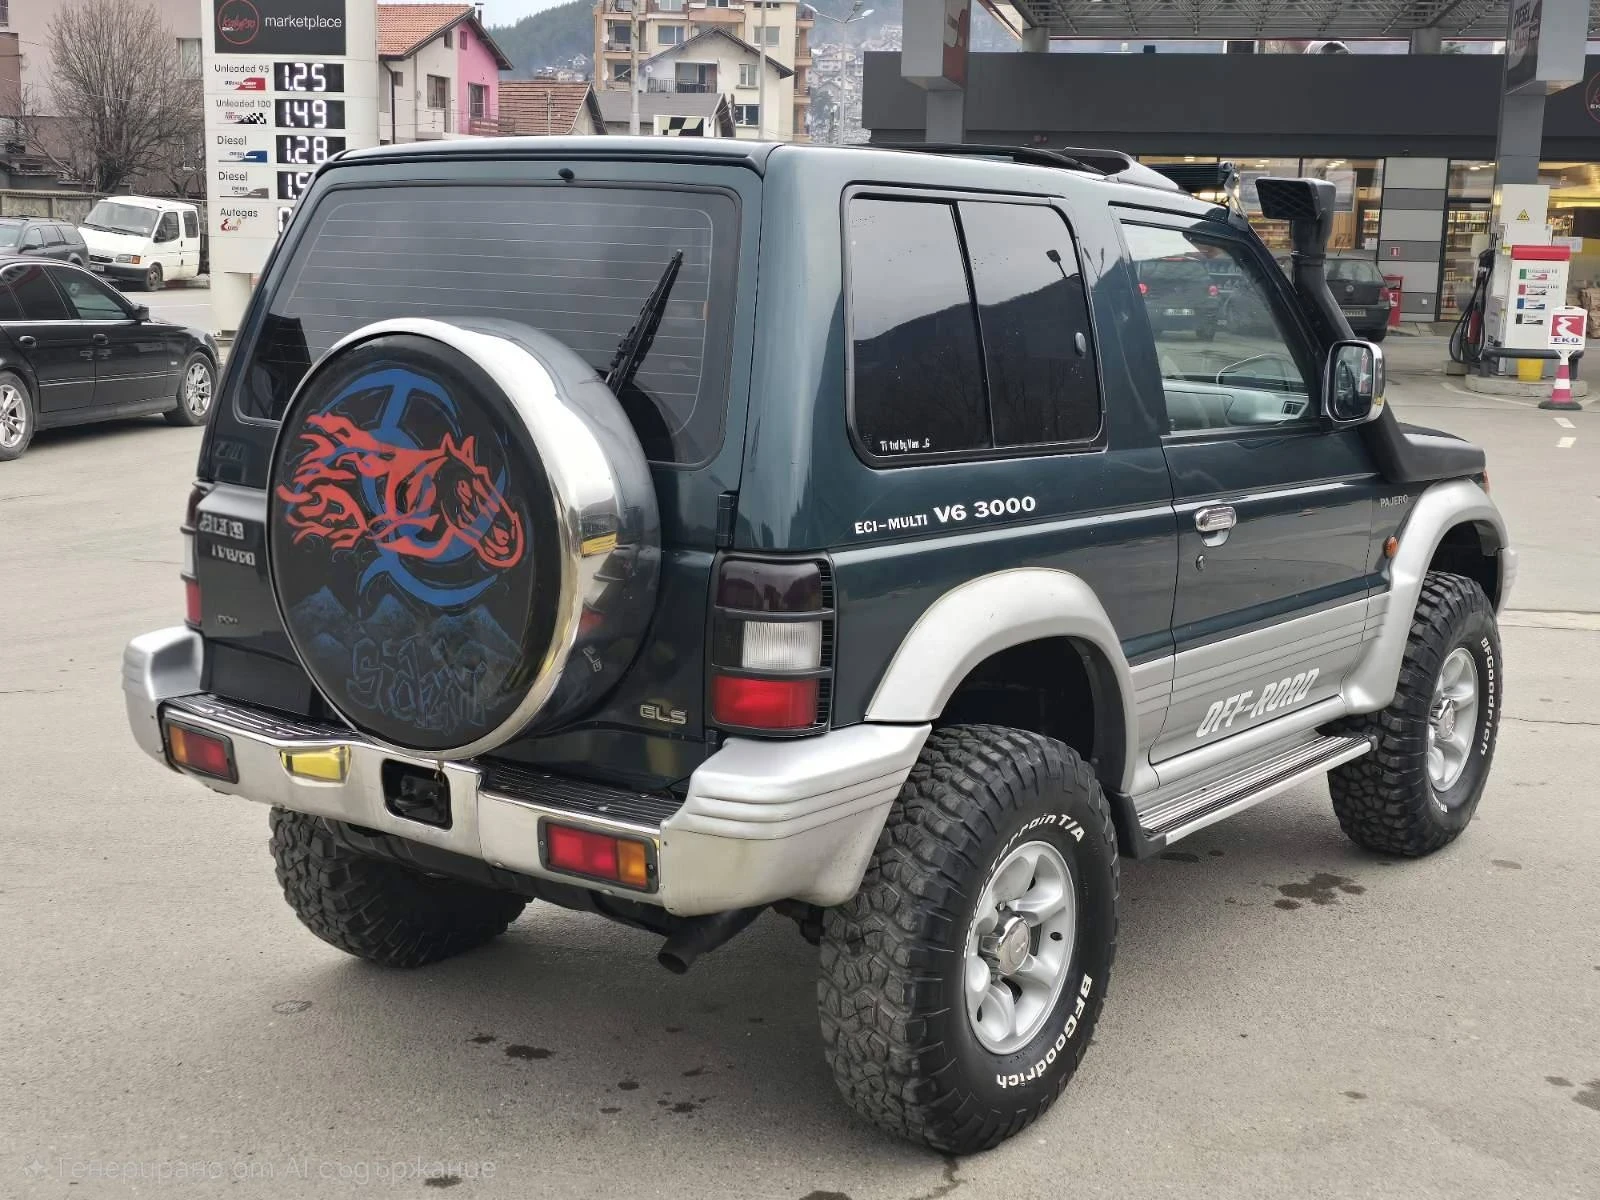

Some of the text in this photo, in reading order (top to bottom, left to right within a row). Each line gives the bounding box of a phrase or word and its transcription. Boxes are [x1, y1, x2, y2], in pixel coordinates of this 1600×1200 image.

[265, 15, 342, 30] marketplace
[214, 63, 270, 73] Unleaded 95
[284, 63, 326, 91] 1.25
[216, 99, 271, 108] Unleaded 100
[285, 99, 327, 128] 1.49
[217, 135, 247, 146] Diesel
[286, 135, 328, 163] 1.28
[218, 171, 248, 182] Diesel
[220, 207, 258, 220] Autogas
[1380, 494, 1409, 508] PAJERO
[854, 495, 1036, 535] ECI-MULTI V6 3000
[1196, 667, 1320, 738] OFF-ROAD
[640, 704, 687, 725] GLS
[1058, 813, 1085, 842] T/A
[996, 973, 1093, 1089] BFGoodrich
